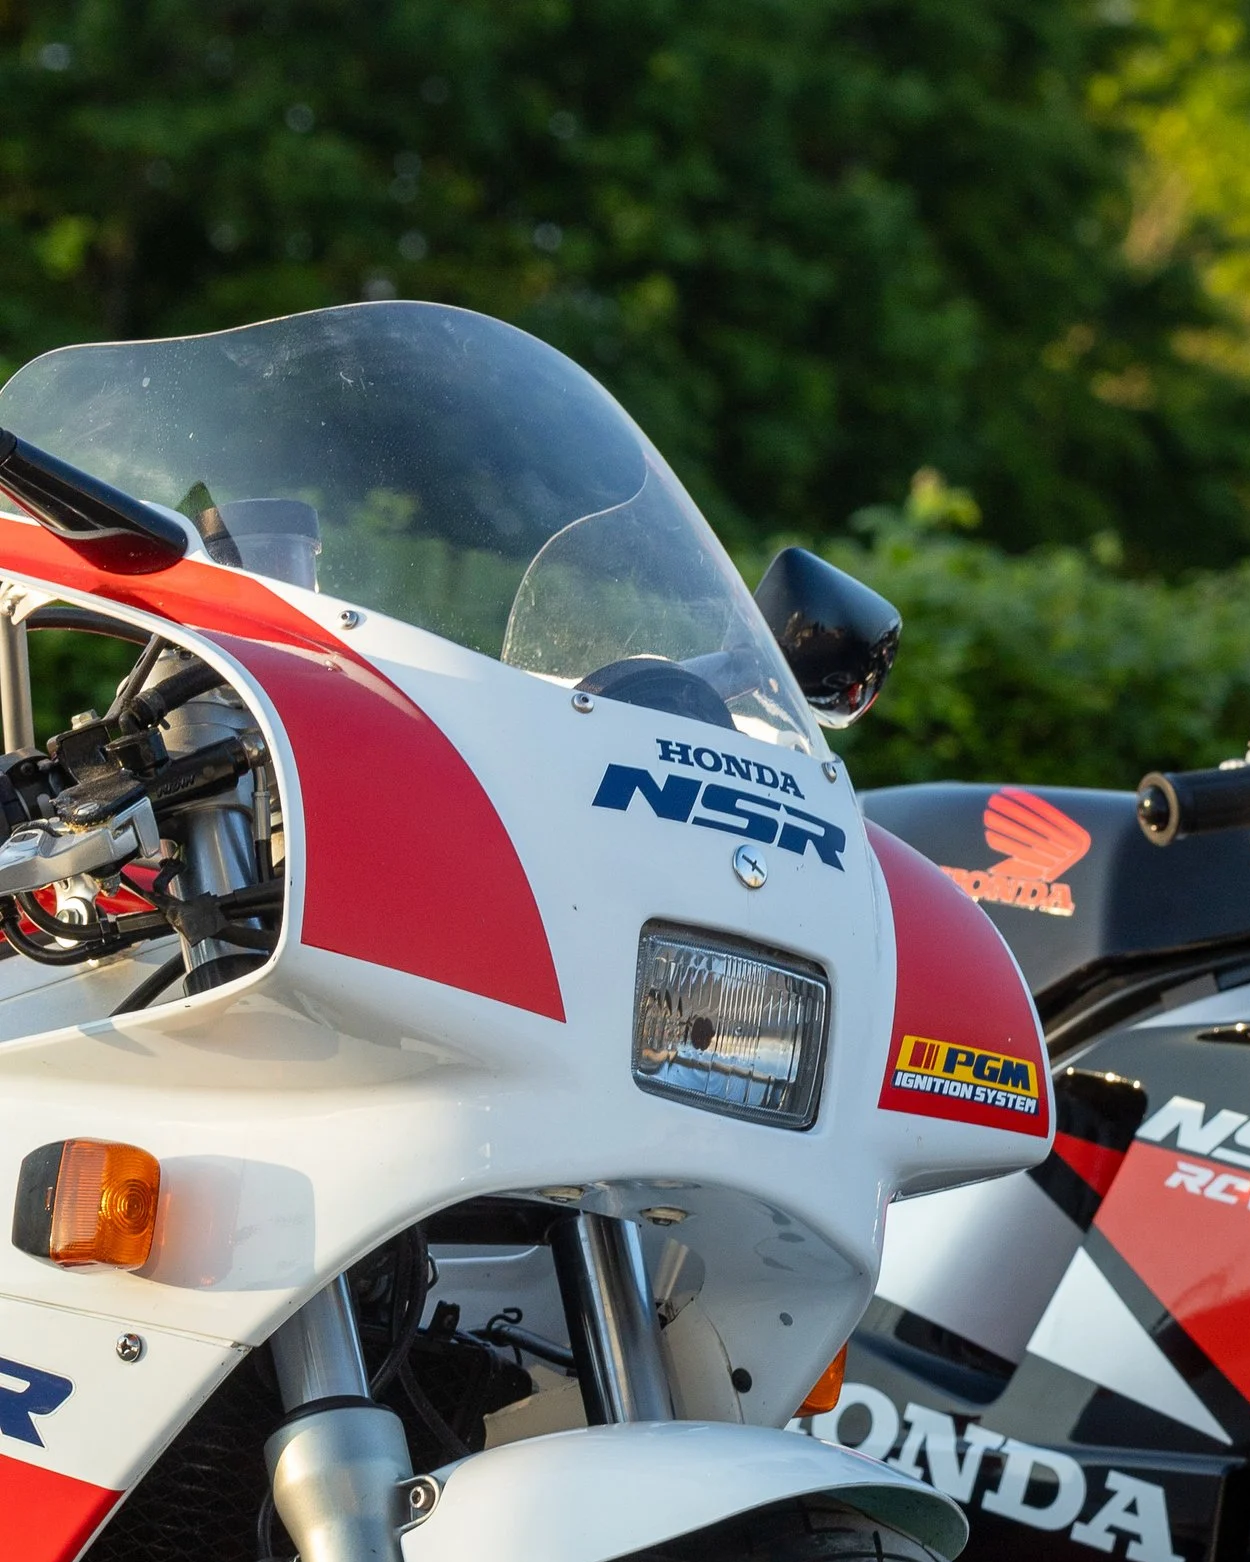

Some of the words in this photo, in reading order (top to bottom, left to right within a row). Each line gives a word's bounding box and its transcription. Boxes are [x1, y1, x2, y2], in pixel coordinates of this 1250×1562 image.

[655, 738, 806, 800] HONDA
[591, 763, 846, 872] NSR
[894, 1071, 974, 1100] IGNITION
[973, 1086, 1037, 1115] SYSTEM
[942, 1046, 1031, 1092] PGM
